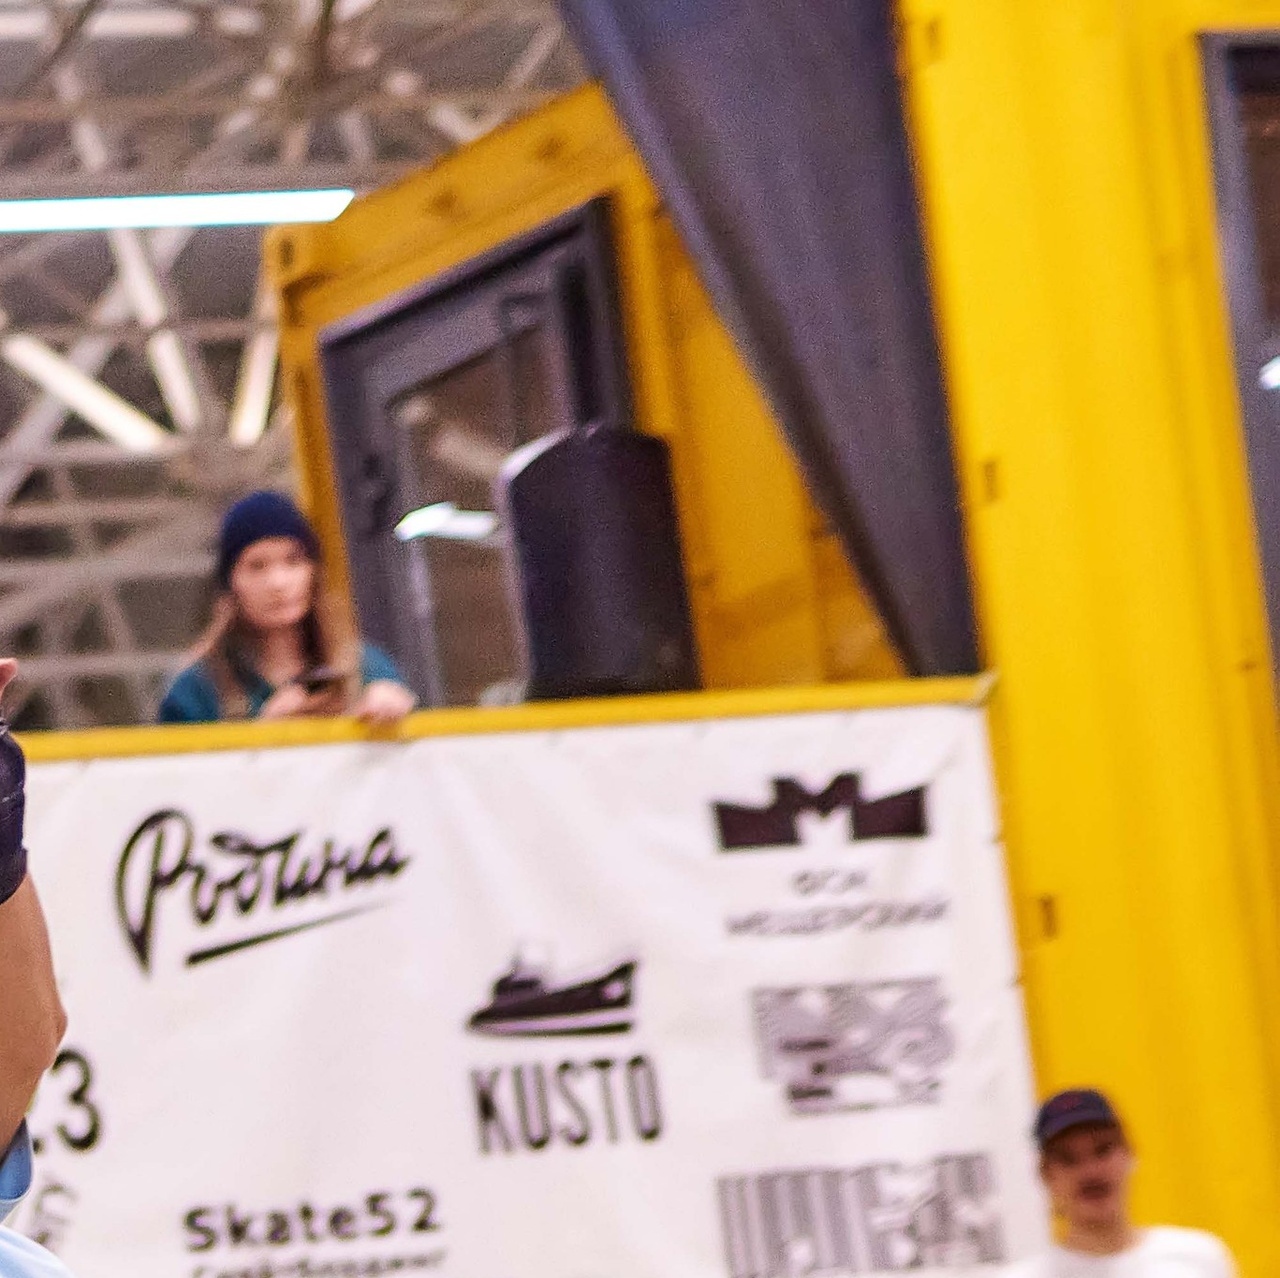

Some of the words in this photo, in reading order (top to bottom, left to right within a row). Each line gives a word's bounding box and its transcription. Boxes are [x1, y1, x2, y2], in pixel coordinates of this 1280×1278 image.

[33, 1047, 101, 1154] 3
[469, 1053, 665, 1155] KUSTO
[183, 1187, 442, 1252] Skate52
